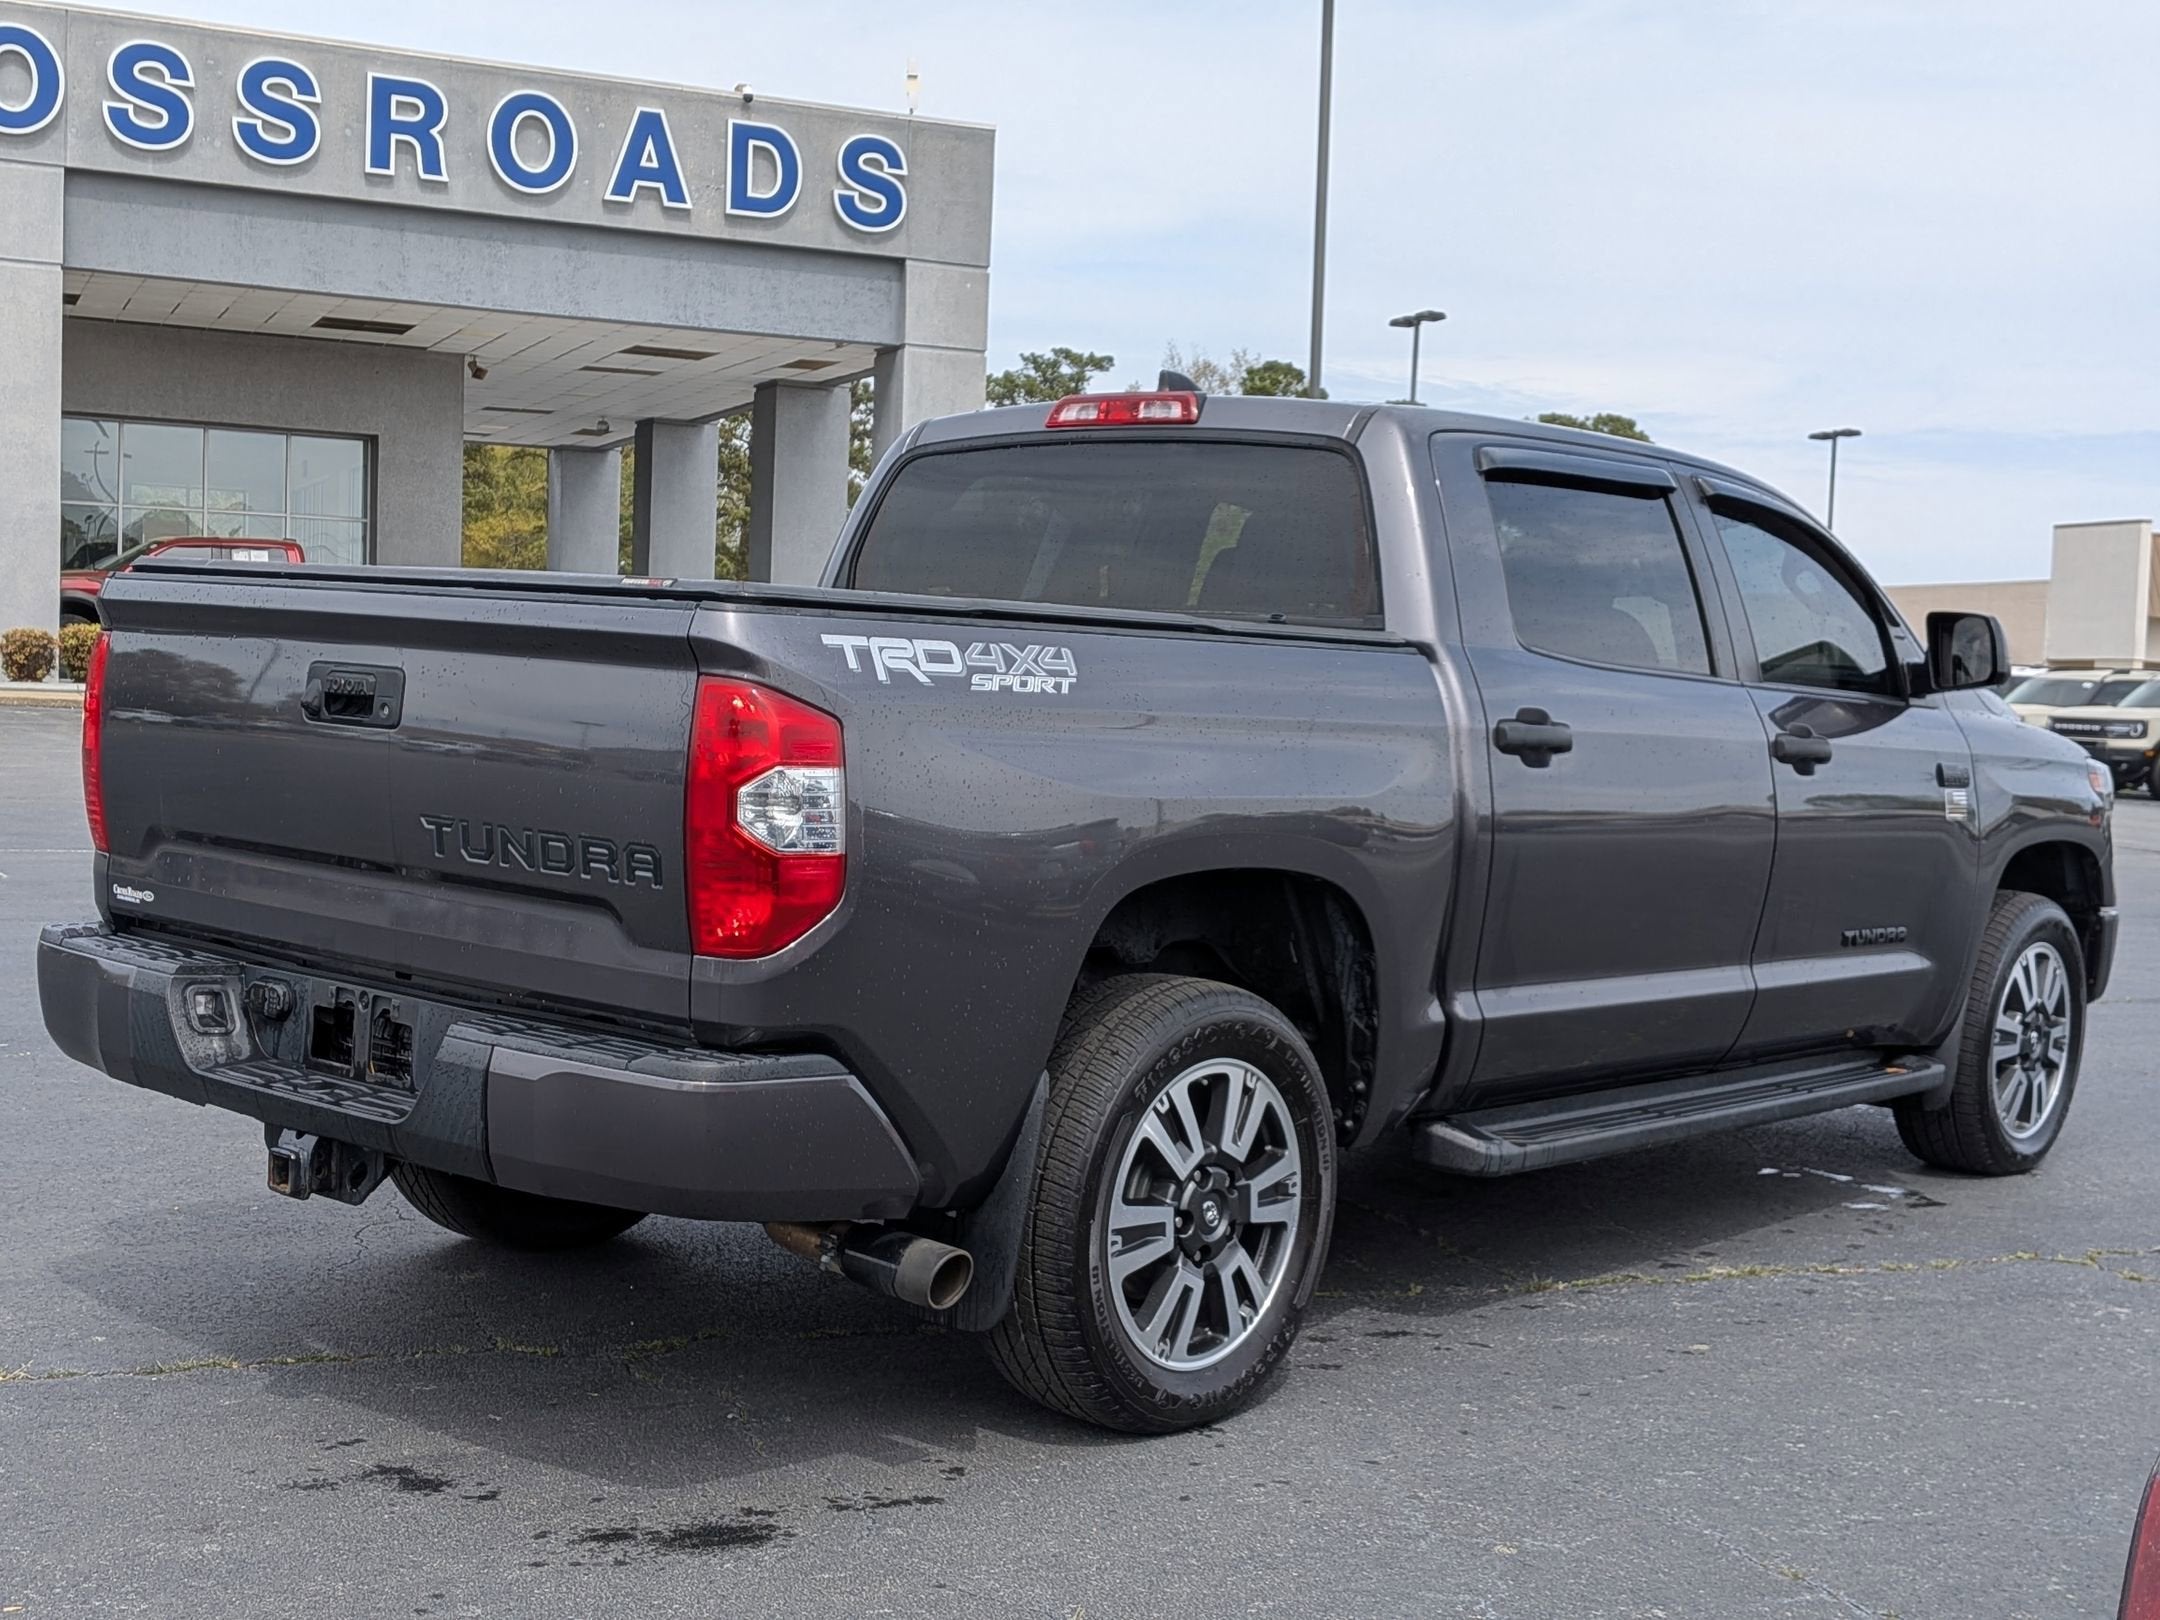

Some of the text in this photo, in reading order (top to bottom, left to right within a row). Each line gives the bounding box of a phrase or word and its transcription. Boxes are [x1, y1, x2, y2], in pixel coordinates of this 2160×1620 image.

[820, 633, 967, 686] TRD
[326, 676, 370, 696] TOYOTA
[970, 673, 1077, 695] SPORT
[419, 813, 664, 891] TUNDRA
[1841, 926, 1908, 947] TUNDRA
